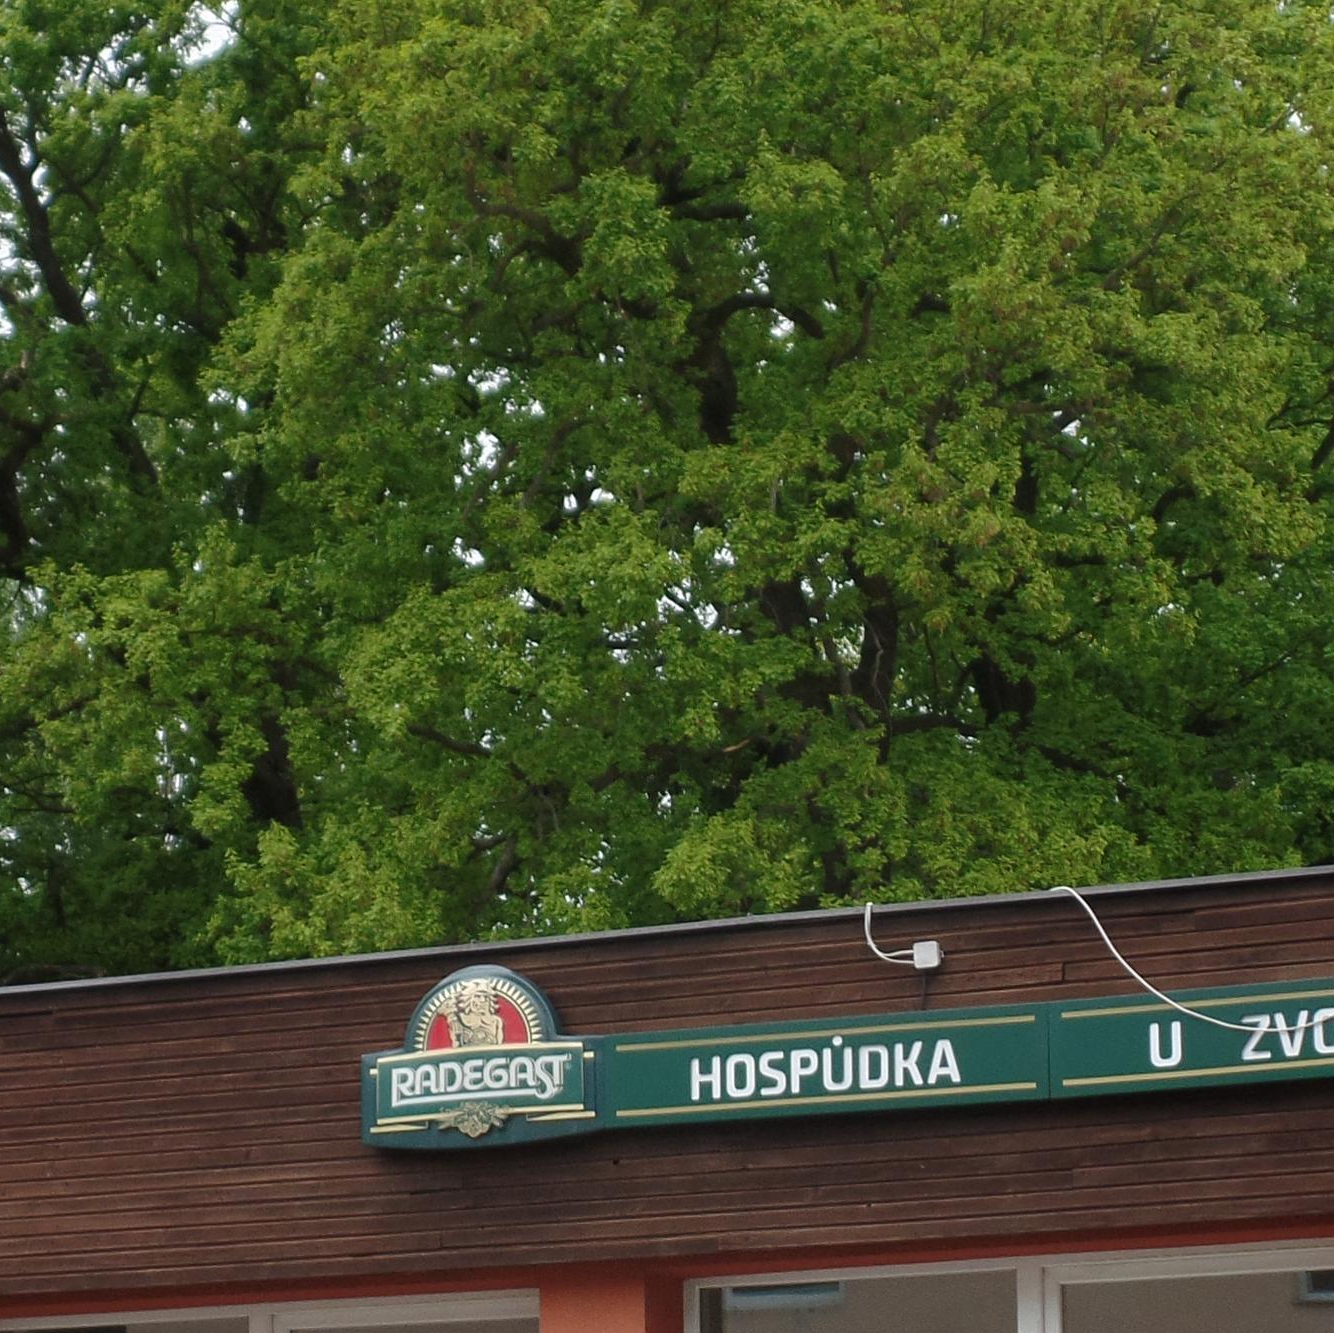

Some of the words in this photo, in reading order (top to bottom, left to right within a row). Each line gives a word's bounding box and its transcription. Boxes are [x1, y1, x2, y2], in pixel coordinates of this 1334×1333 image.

[391, 1054, 567, 1107] RADEGAST
[690, 1036, 960, 1101] HOSPŮDKA
[1149, 1021, 1181, 1067] U
